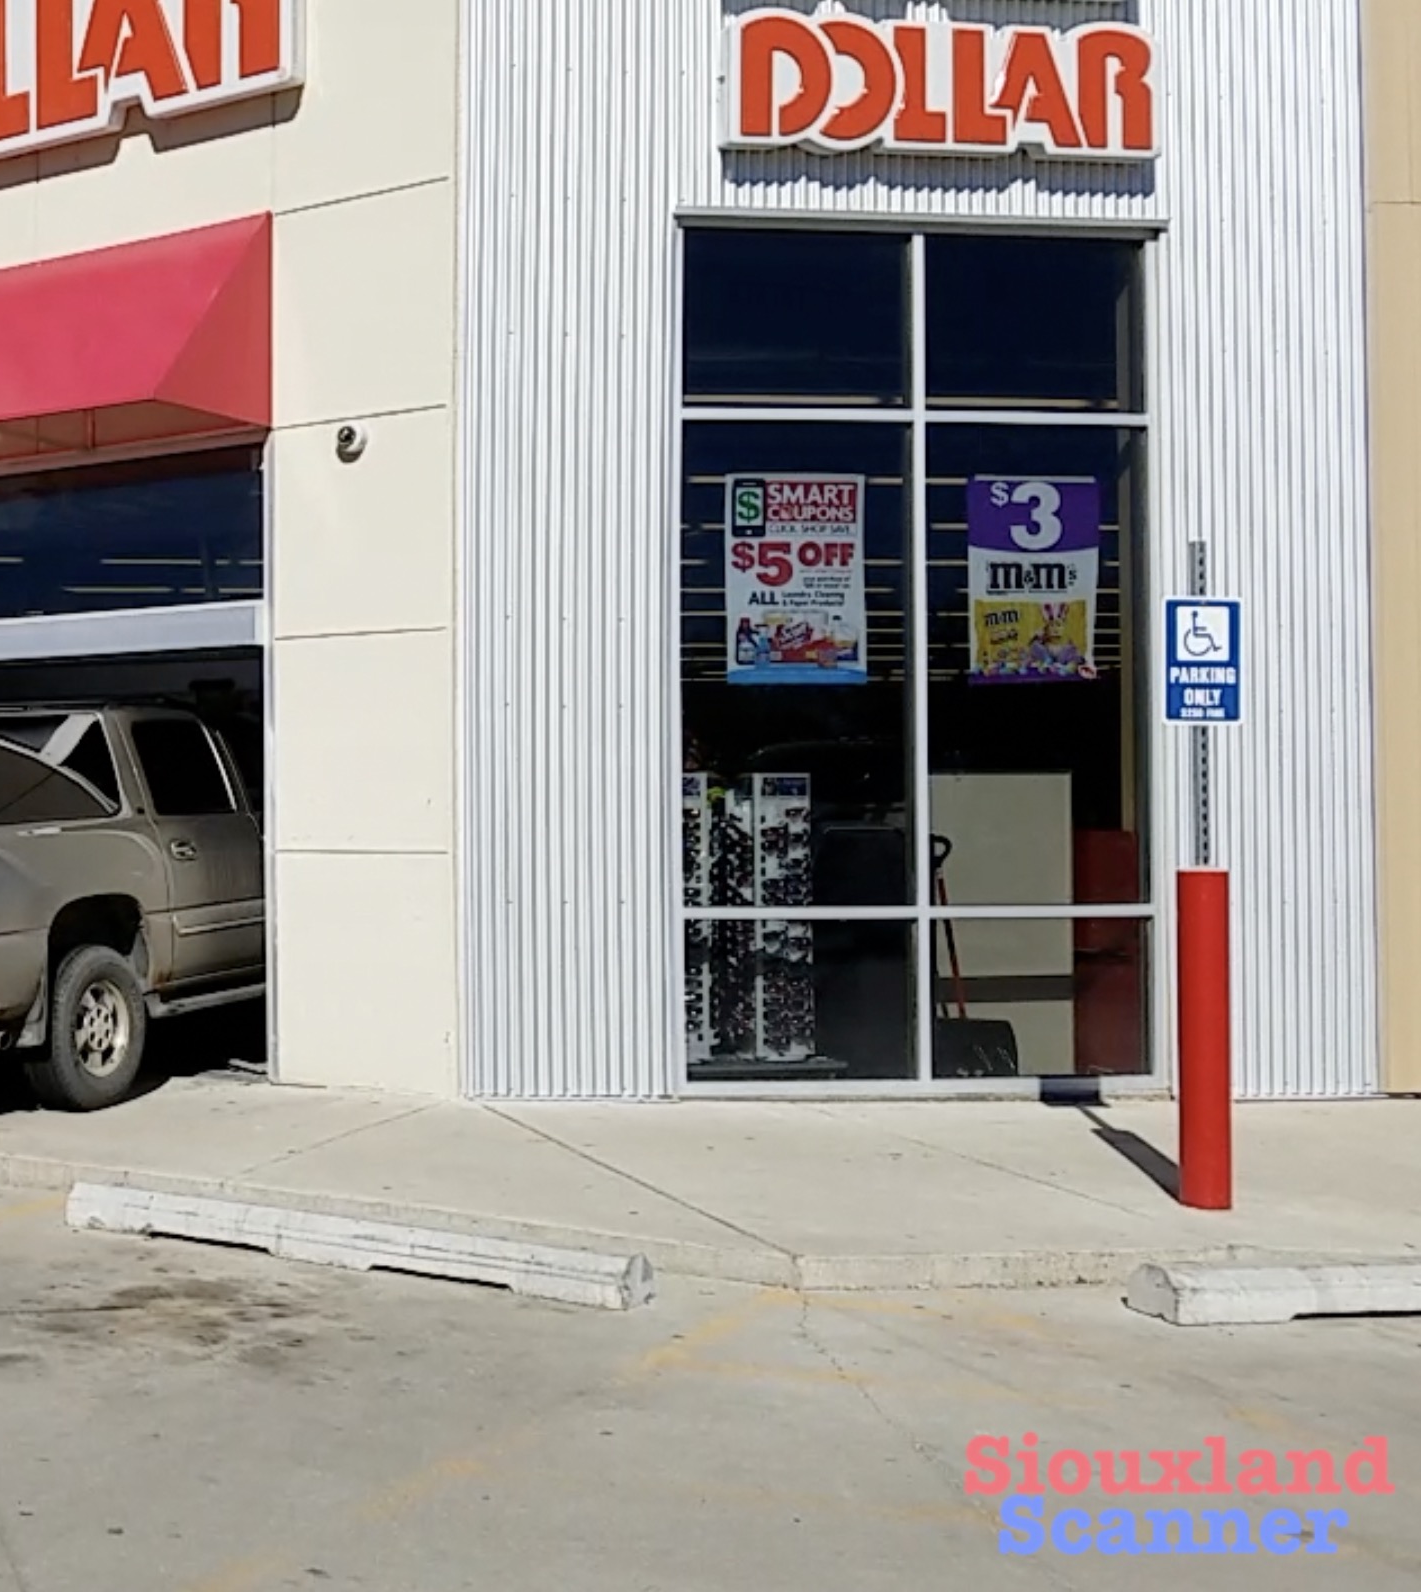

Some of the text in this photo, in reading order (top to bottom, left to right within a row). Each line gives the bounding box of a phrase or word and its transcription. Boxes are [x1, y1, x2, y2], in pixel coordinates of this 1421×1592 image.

[740, 16, 1152, 150] DOLLAR
[767, 484, 855, 504] SMART
[767, 505, 855, 521] COUPONS
[990, 481, 1063, 550] $3
[731, 541, 856, 587] $5 OFF
[748, 591, 779, 606] ALL
[1170, 667, 1237, 685] PARKING
[1183, 688, 1222, 706] ONLY
